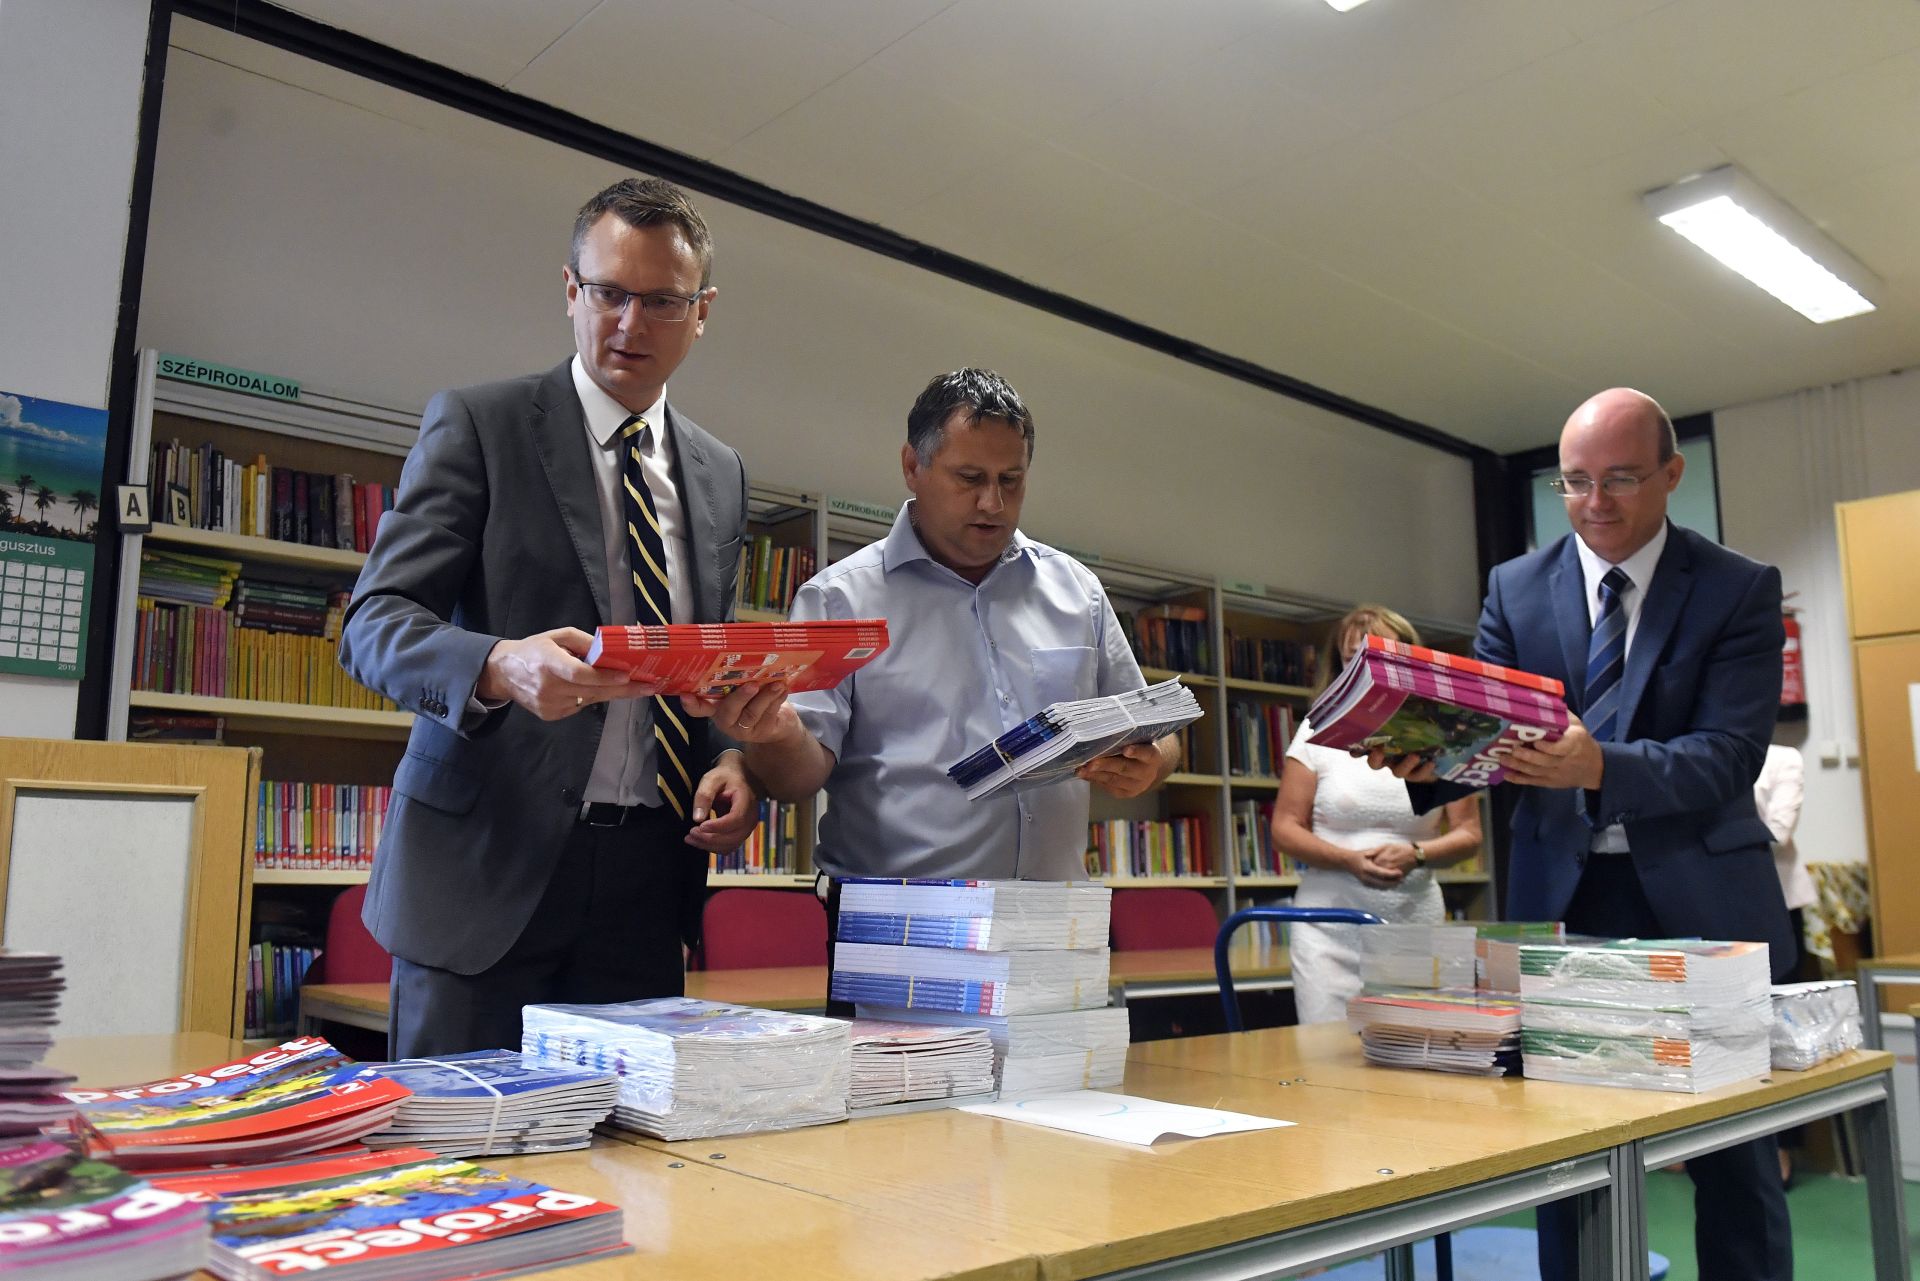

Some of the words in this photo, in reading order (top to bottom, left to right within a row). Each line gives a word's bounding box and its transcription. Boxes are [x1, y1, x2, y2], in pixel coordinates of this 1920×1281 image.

[162, 359, 299, 398] SZÉPIRODALOM
[127, 492, 142, 517] A
[177, 498, 186, 520] B
[58, 663, 76, 671] 2019
[61, 1037, 322, 1105] Project
[336, 1082, 365, 1094] 2
[250, 1189, 599, 1271] Project
